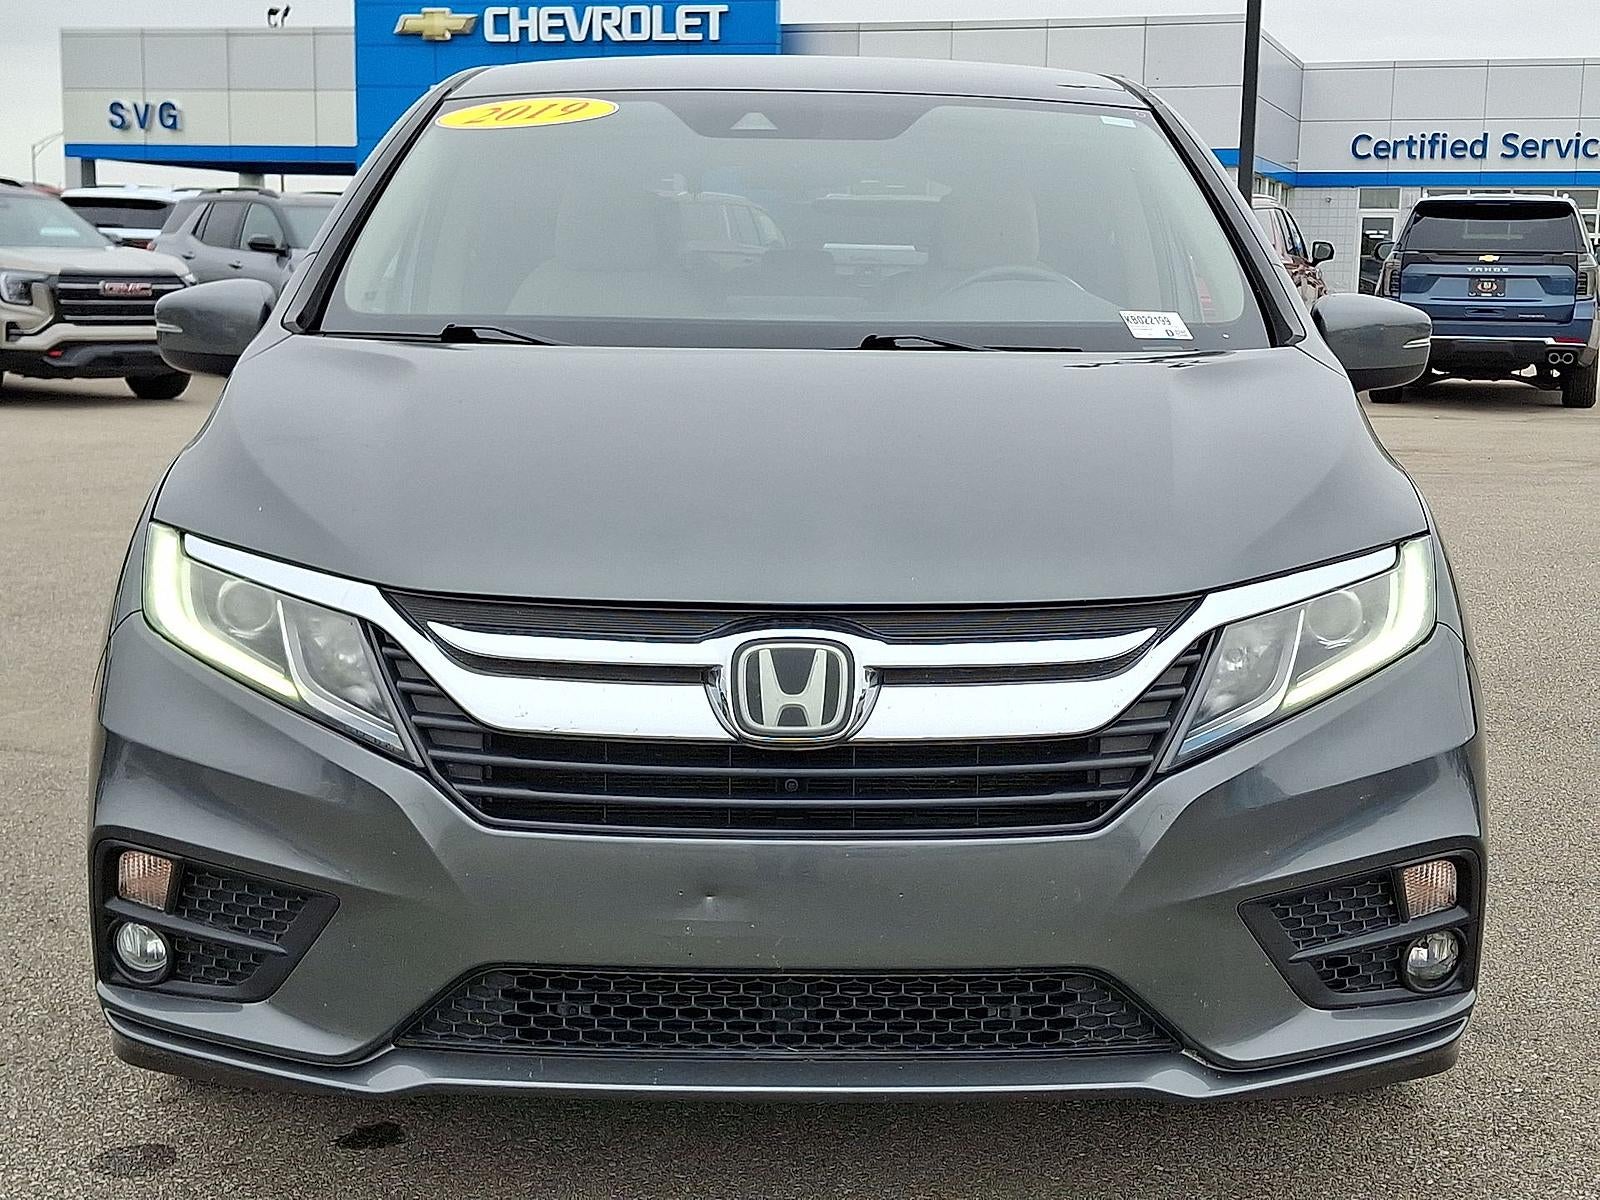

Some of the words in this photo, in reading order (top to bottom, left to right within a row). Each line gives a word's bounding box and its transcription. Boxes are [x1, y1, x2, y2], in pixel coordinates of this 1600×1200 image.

[483, 4, 729, 43] CHEVROLET
[108, 101, 180, 131] SVG
[464, 101, 589, 125] 2019
[1351, 132, 1489, 160] Certified
[1500, 131, 1600, 160] Servic
